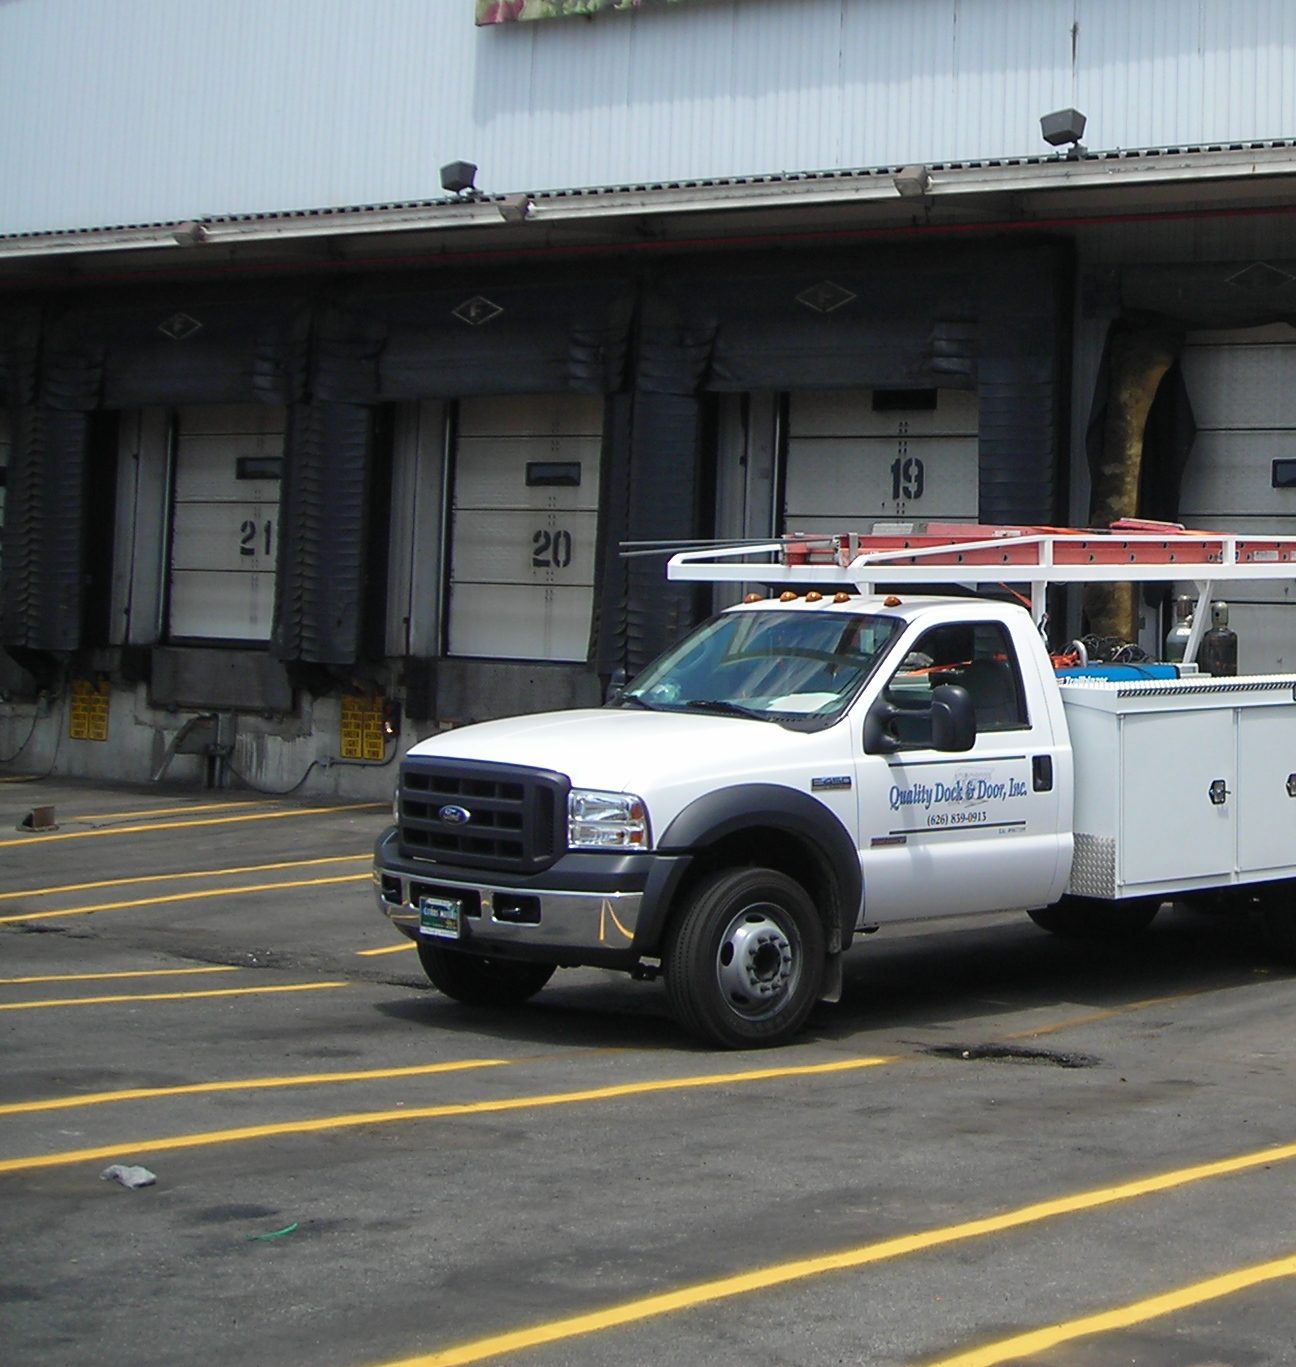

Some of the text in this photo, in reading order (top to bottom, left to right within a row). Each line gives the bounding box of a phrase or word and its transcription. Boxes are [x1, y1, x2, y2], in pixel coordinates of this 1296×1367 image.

[891, 457, 925, 501] 19
[239, 520, 272, 556] 21
[532, 529, 572, 569] 20
[889, 777, 1028, 811] Quality Dock & Door, Inc.
[927, 814, 949, 827] (626)
